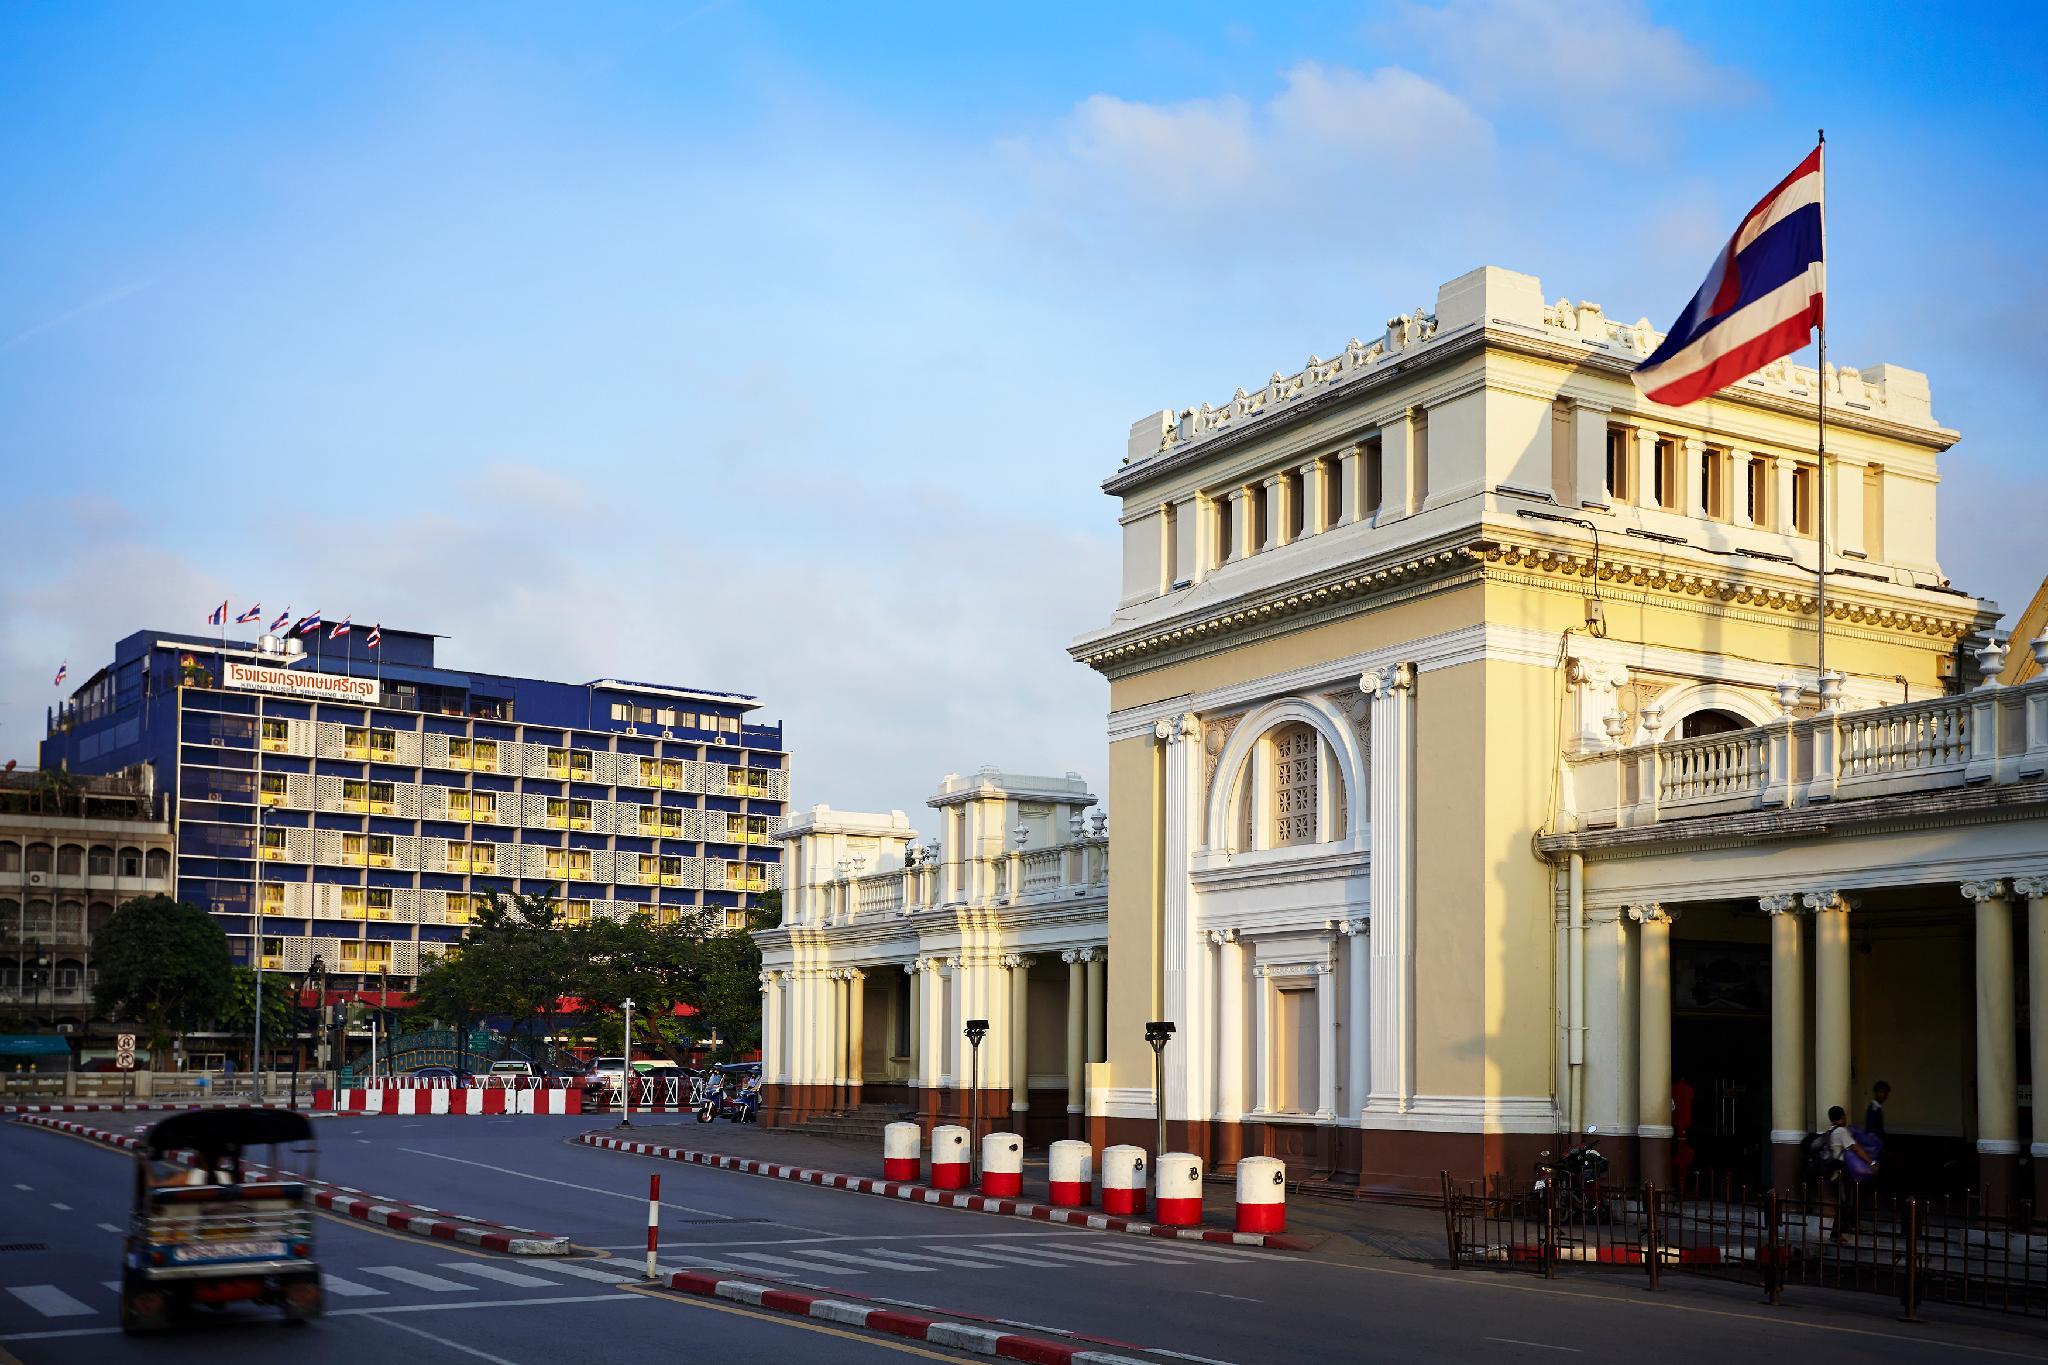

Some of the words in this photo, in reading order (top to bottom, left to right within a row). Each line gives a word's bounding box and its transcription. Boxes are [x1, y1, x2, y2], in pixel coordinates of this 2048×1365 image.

[231, 664, 374, 697] โรงแรมกรุงเกษมศรีกรุง
[240, 682, 268, 690] KRUNG
[271, 685, 297, 694] KASEM
[340, 693, 363, 701] HOTEL
